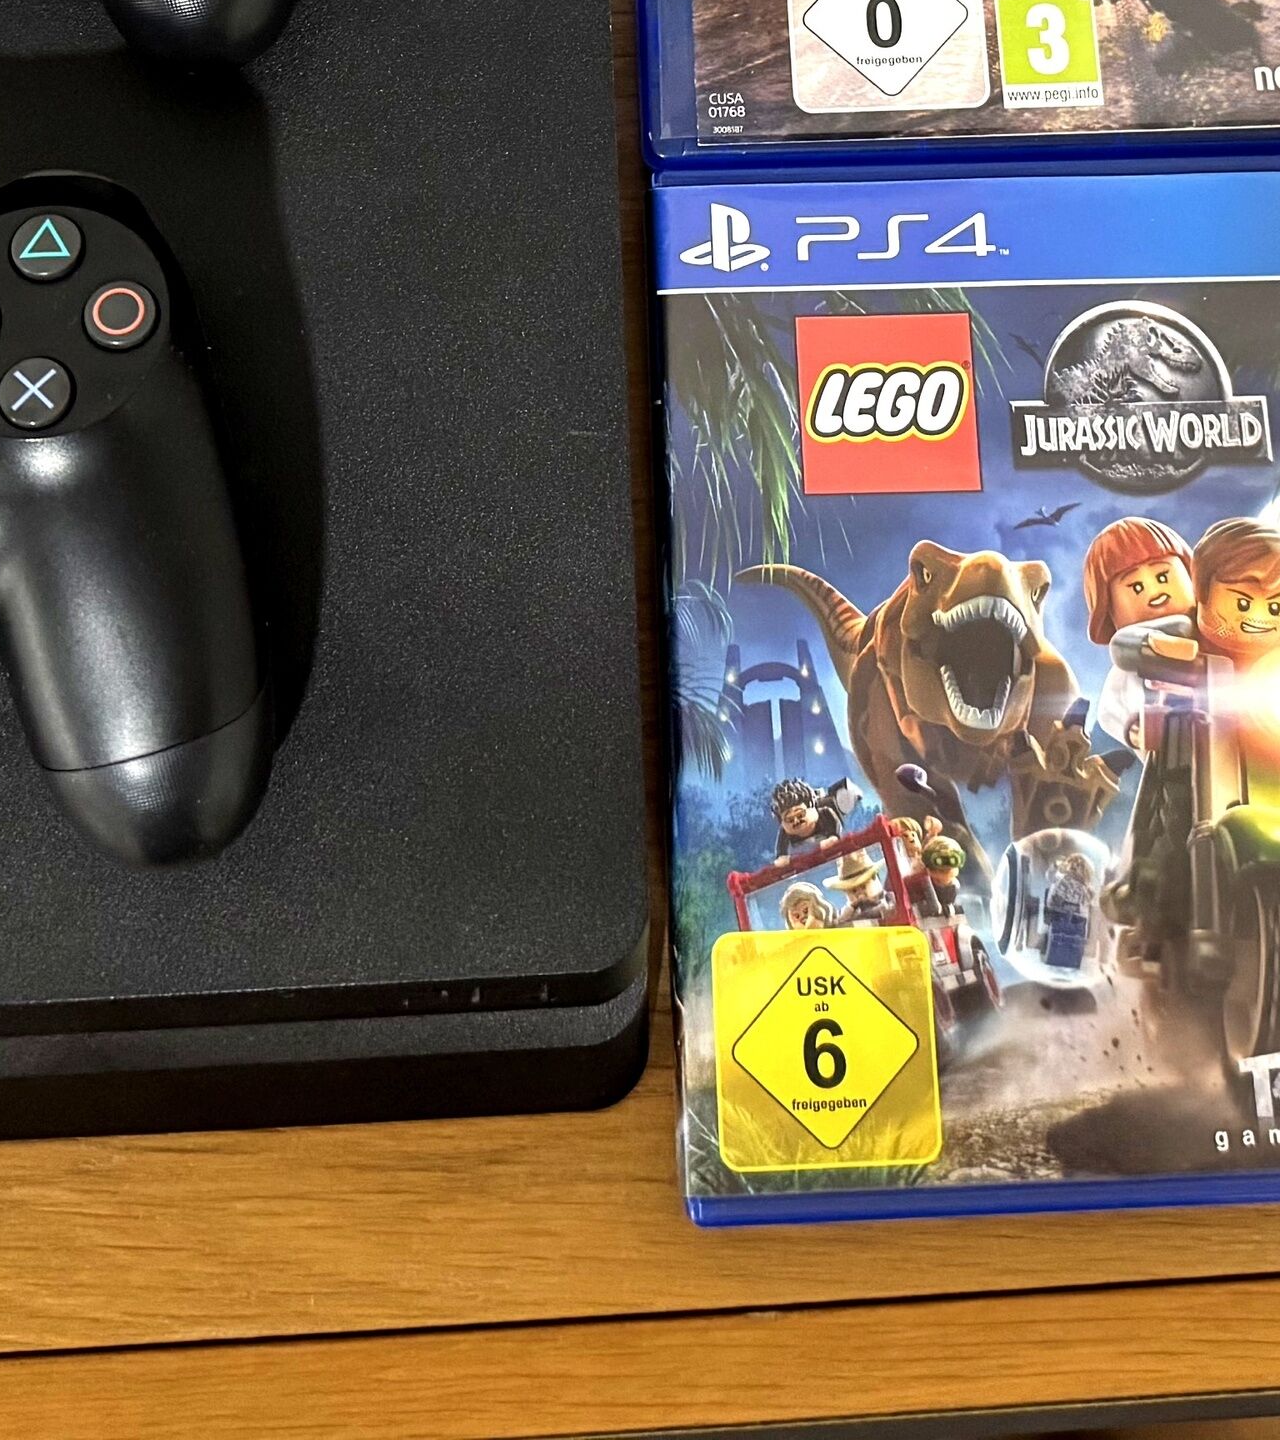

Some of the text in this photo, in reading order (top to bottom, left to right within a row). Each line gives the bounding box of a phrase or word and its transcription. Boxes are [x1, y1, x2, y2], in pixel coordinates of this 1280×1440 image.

[1024, 2, 1071, 76] 3
[856, 56, 924, 68] freigegeben
[708, 92, 745, 105] CUSA
[1007, 85, 1100, 103] www.pegi.info
[707, 105, 747, 119] 01768
[795, 212, 997, 261] PS4
[811, 366, 965, 438] LEGO
[1020, 410, 1263, 456] JURASSIC WORLD
[796, 975, 847, 997] USK
[814, 1000, 830, 1013] ab
[803, 1017, 847, 1090] 6
[792, 1096, 868, 1113] freigegeben
